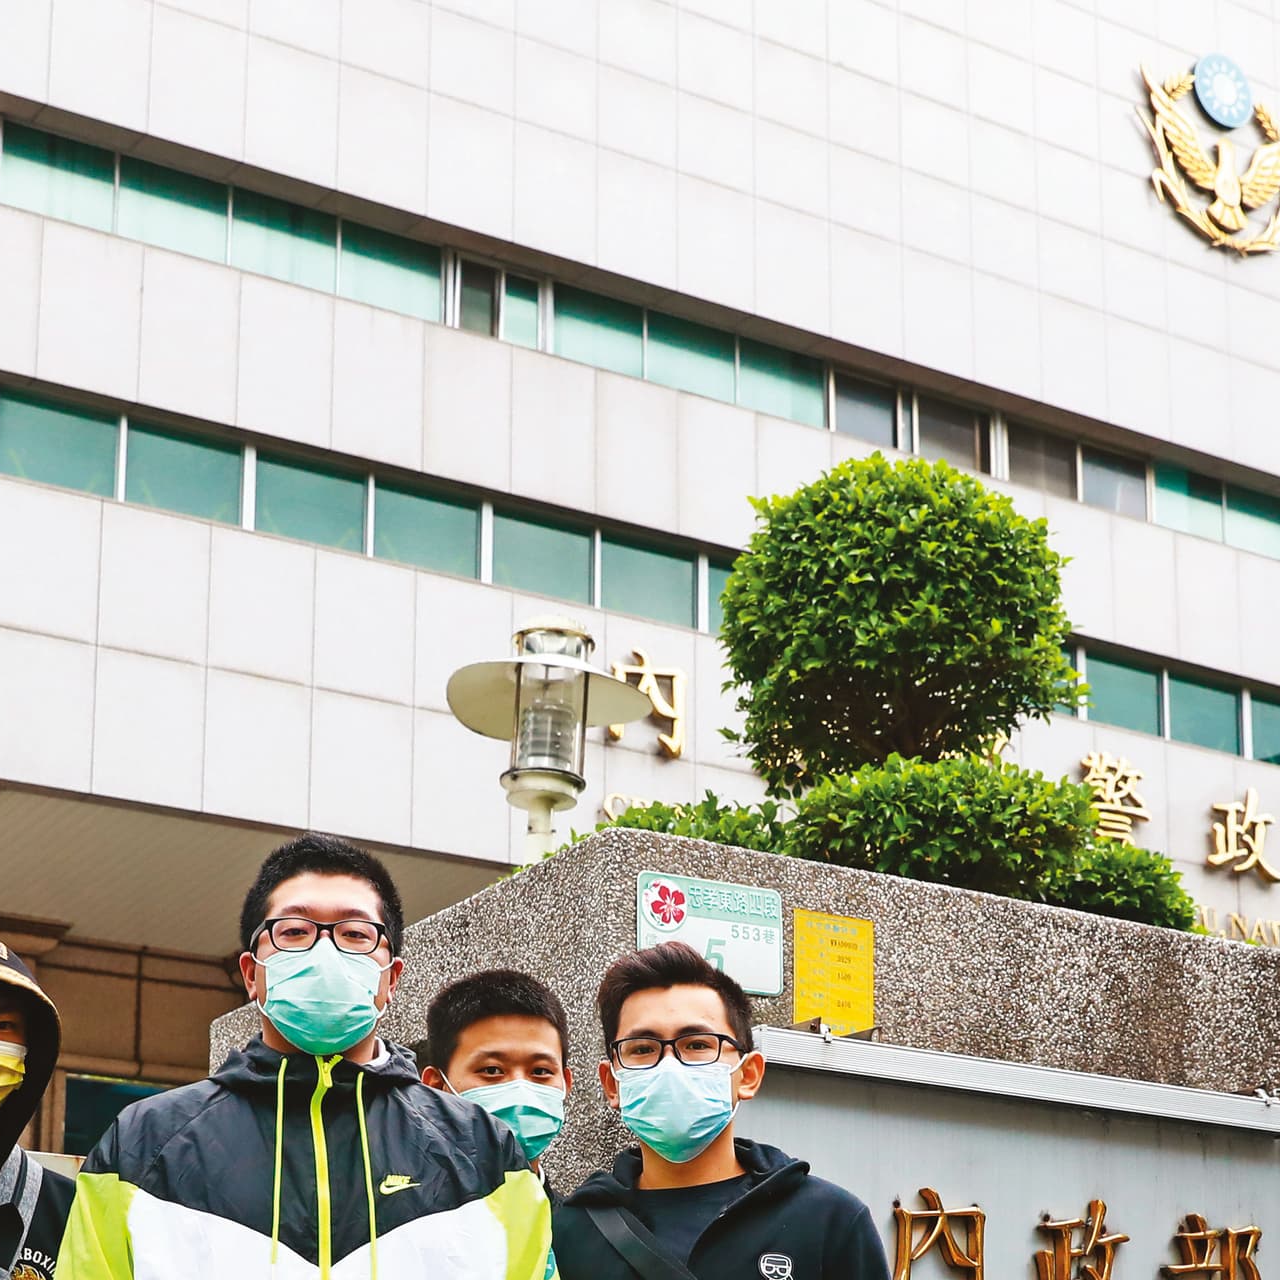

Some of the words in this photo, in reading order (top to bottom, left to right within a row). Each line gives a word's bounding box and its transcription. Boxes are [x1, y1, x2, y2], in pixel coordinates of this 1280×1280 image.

[687, 886, 778, 920] 忠孝東路四段
[730, 924, 776, 945] 553巷
[385, 1174, 412, 1186] NIKE
